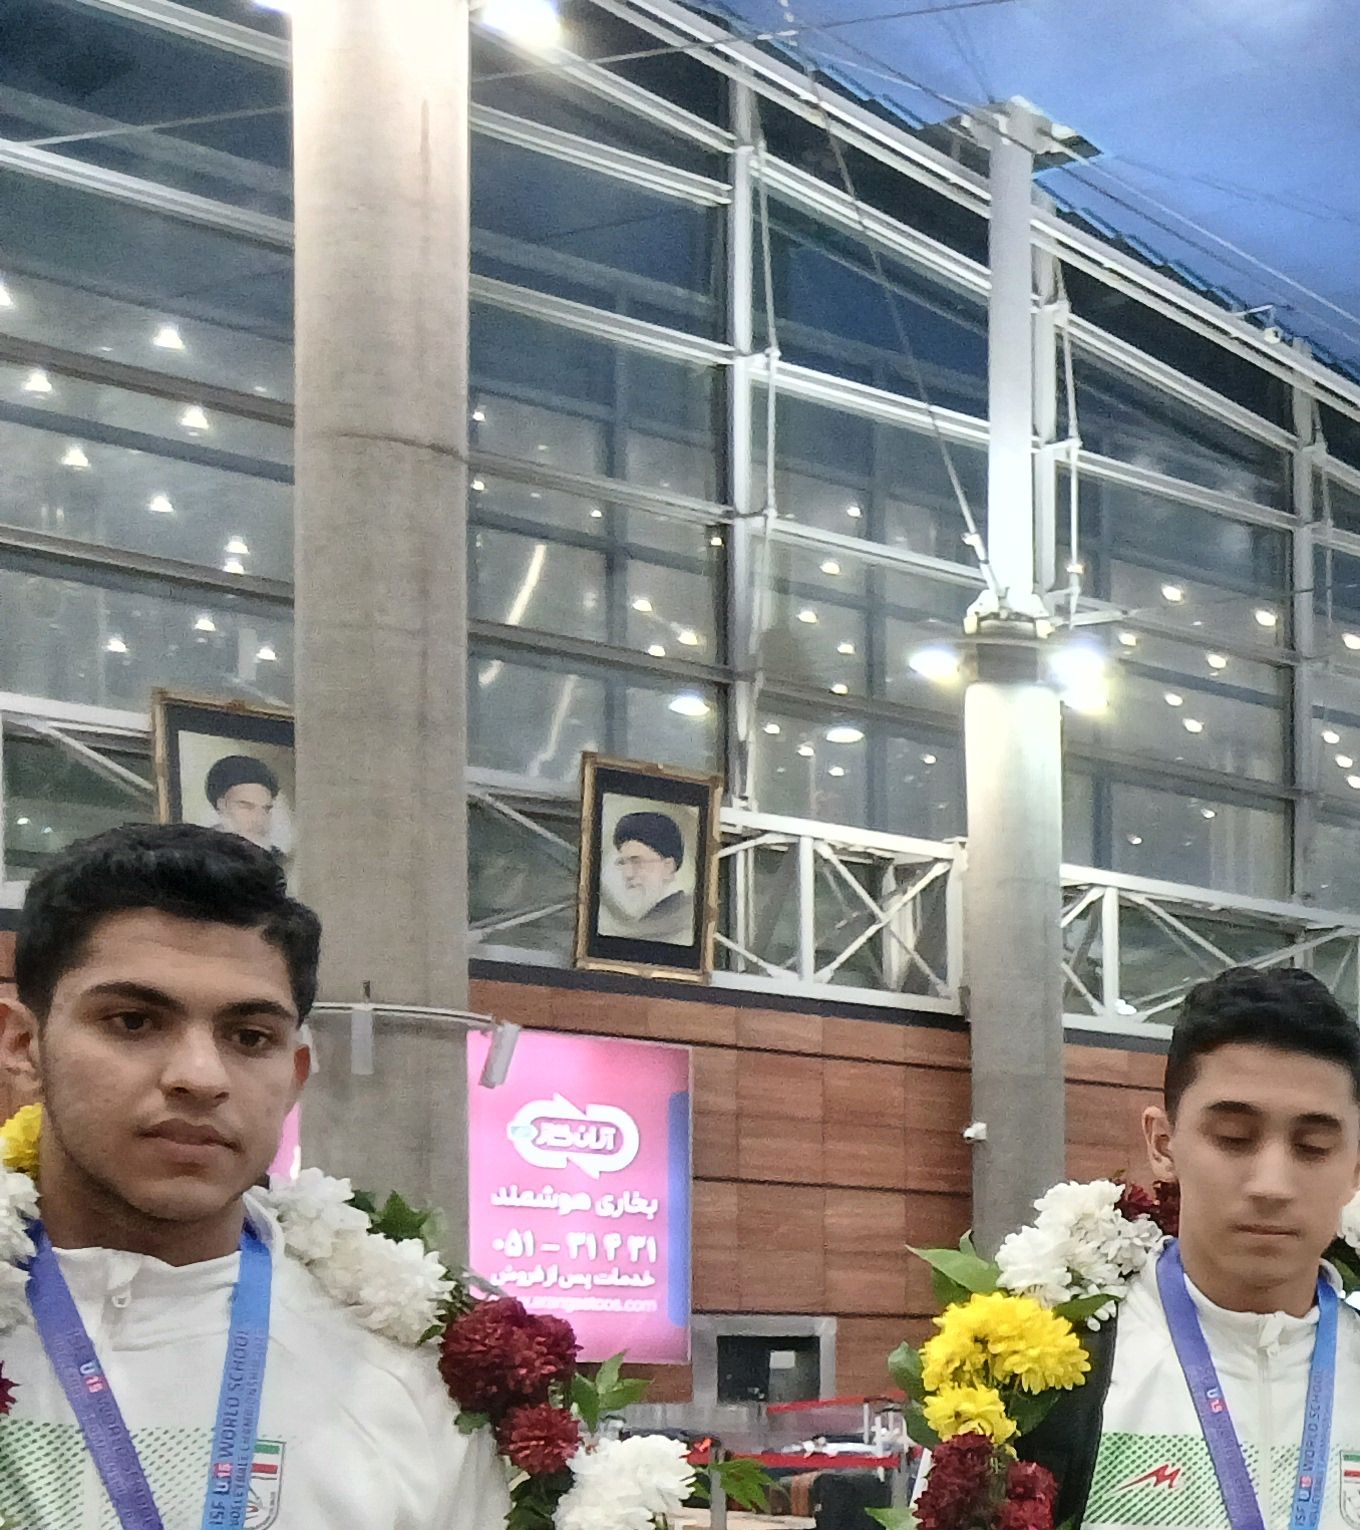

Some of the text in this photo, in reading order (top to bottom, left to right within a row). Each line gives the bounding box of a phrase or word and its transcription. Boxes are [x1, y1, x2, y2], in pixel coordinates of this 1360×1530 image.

[490, 1184, 658, 1220] بخاری هوشمند
[490, 1264, 545, 1287] فروش
[558, 1273, 592, 1290] پس
[593, 1267, 656, 1287] خدمات
[228, 1328, 248, 1393] SCHOOL
[218, 1395, 240, 1460] WORLD
[208, 1499, 226, 1526] ISF
